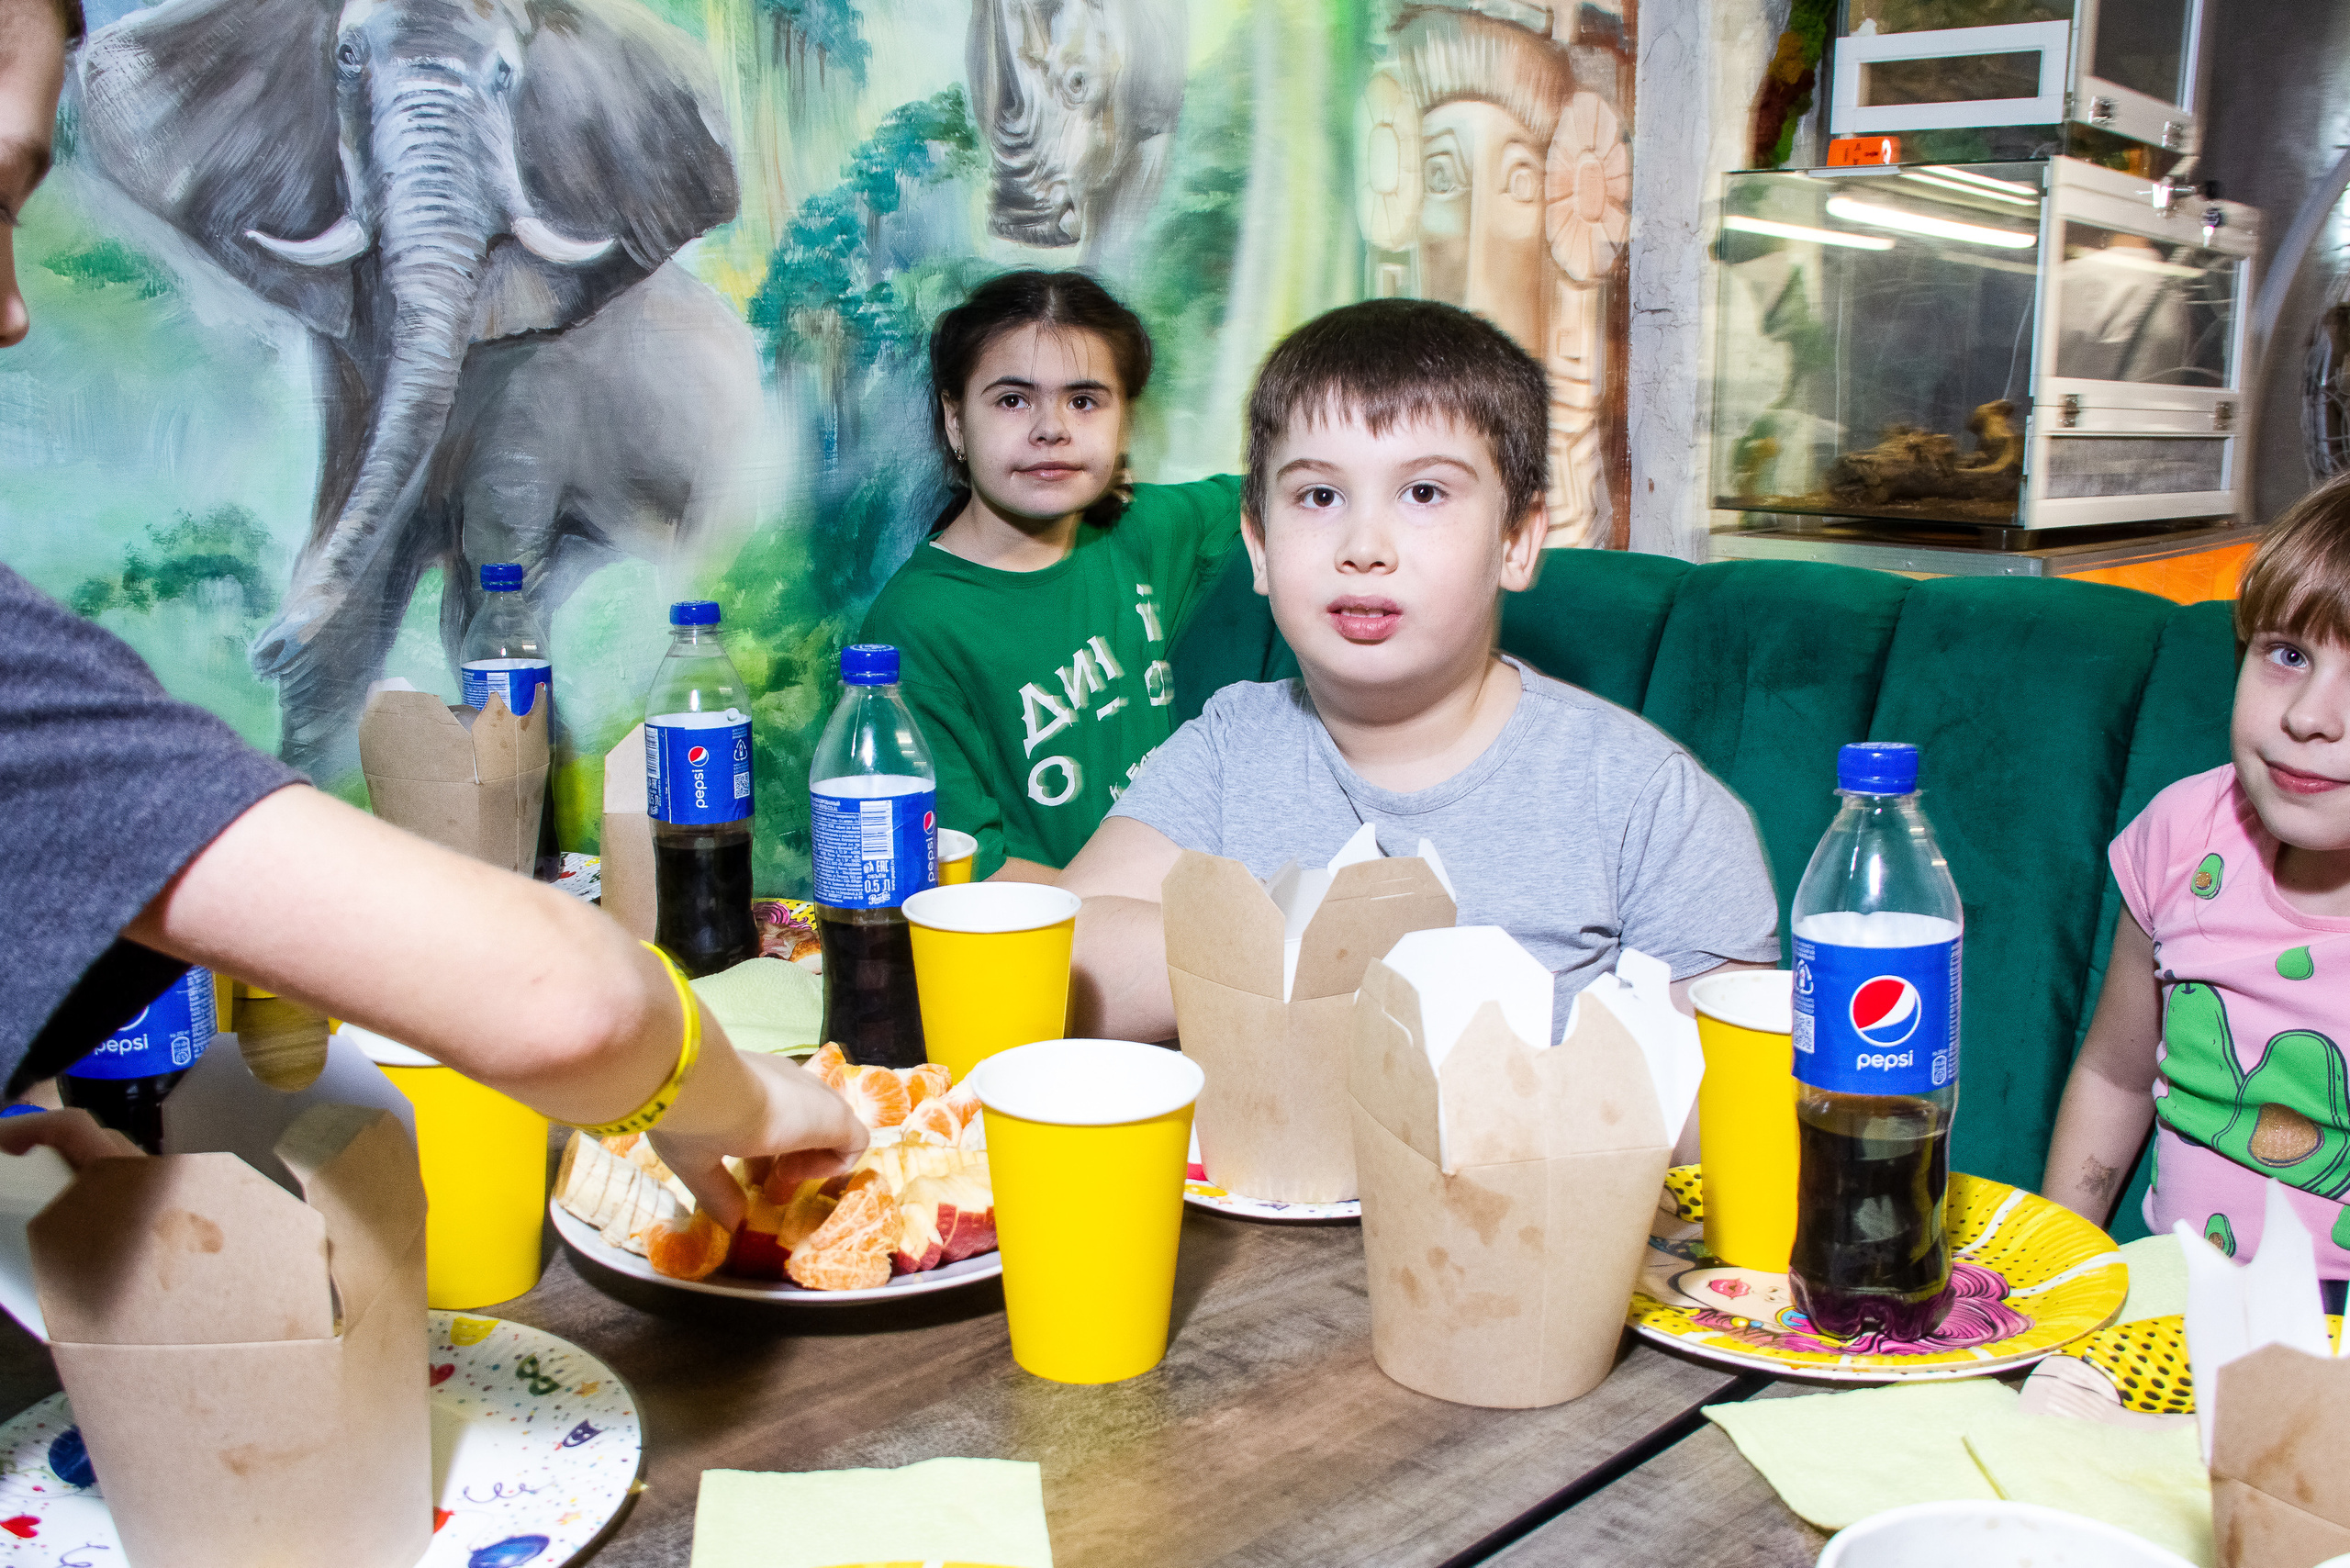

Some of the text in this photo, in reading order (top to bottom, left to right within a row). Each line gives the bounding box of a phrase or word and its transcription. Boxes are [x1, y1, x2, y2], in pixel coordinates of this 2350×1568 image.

[691, 768, 709, 809] pepsi
[925, 836, 936, 883] pepsi
[1856, 1049, 1914, 1072] pepsi
